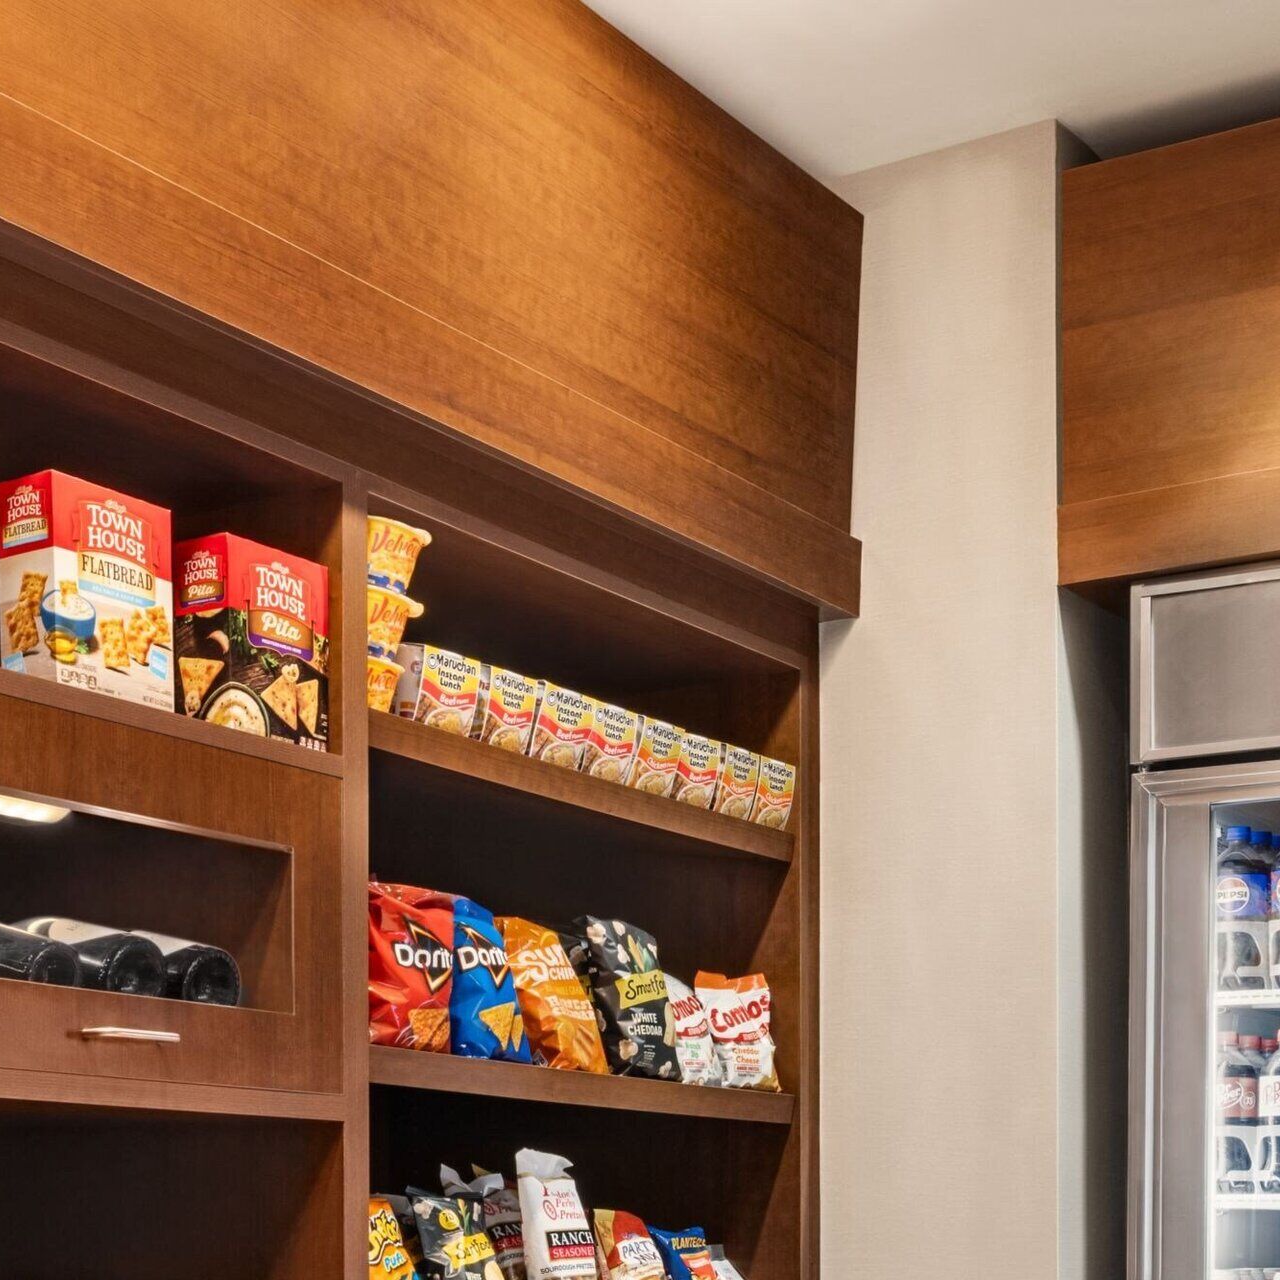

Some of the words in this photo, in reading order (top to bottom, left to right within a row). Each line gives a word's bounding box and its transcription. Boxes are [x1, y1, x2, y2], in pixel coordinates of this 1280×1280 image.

[7, 490, 40, 509] TOWN
[7, 504, 42, 523] HOUSE
[86, 503, 143, 541] TOWN
[4, 519, 47, 539] FLATBREAD
[87, 526, 146, 565] HOUSE
[81, 553, 154, 592] FLATBREAD
[184, 555, 217, 573] TOWN
[184, 567, 219, 586] HOUSE
[255, 565, 304, 600] TOWN
[187, 584, 216, 598] Pita
[256, 586, 307, 621] HOUSE
[261, 611, 302, 640] Pita
[436, 653, 477, 677] Maruchan
[437, 668, 465, 684] Instant
[439, 678, 462, 692] Lunch
[500, 674, 535, 695] Maruchan
[502, 688, 525, 702] Instant
[503, 698, 521, 710] Lunch
[555, 689, 593, 712] Maruchan
[556, 704, 583, 720] Instant
[557, 714, 578, 727] Lunch
[603, 708, 635, 728] Maruchan
[604, 721, 626, 735] Instant
[605, 729, 623, 742] Lunch
[652, 725, 682, 744] Maruchan
[687, 738, 718, 756] Maruchan
[631, 1013, 658, 1024] WHITE
[626, 1025, 663, 1037] CHEDDAR
[549, 1230, 594, 1248] RANCH
